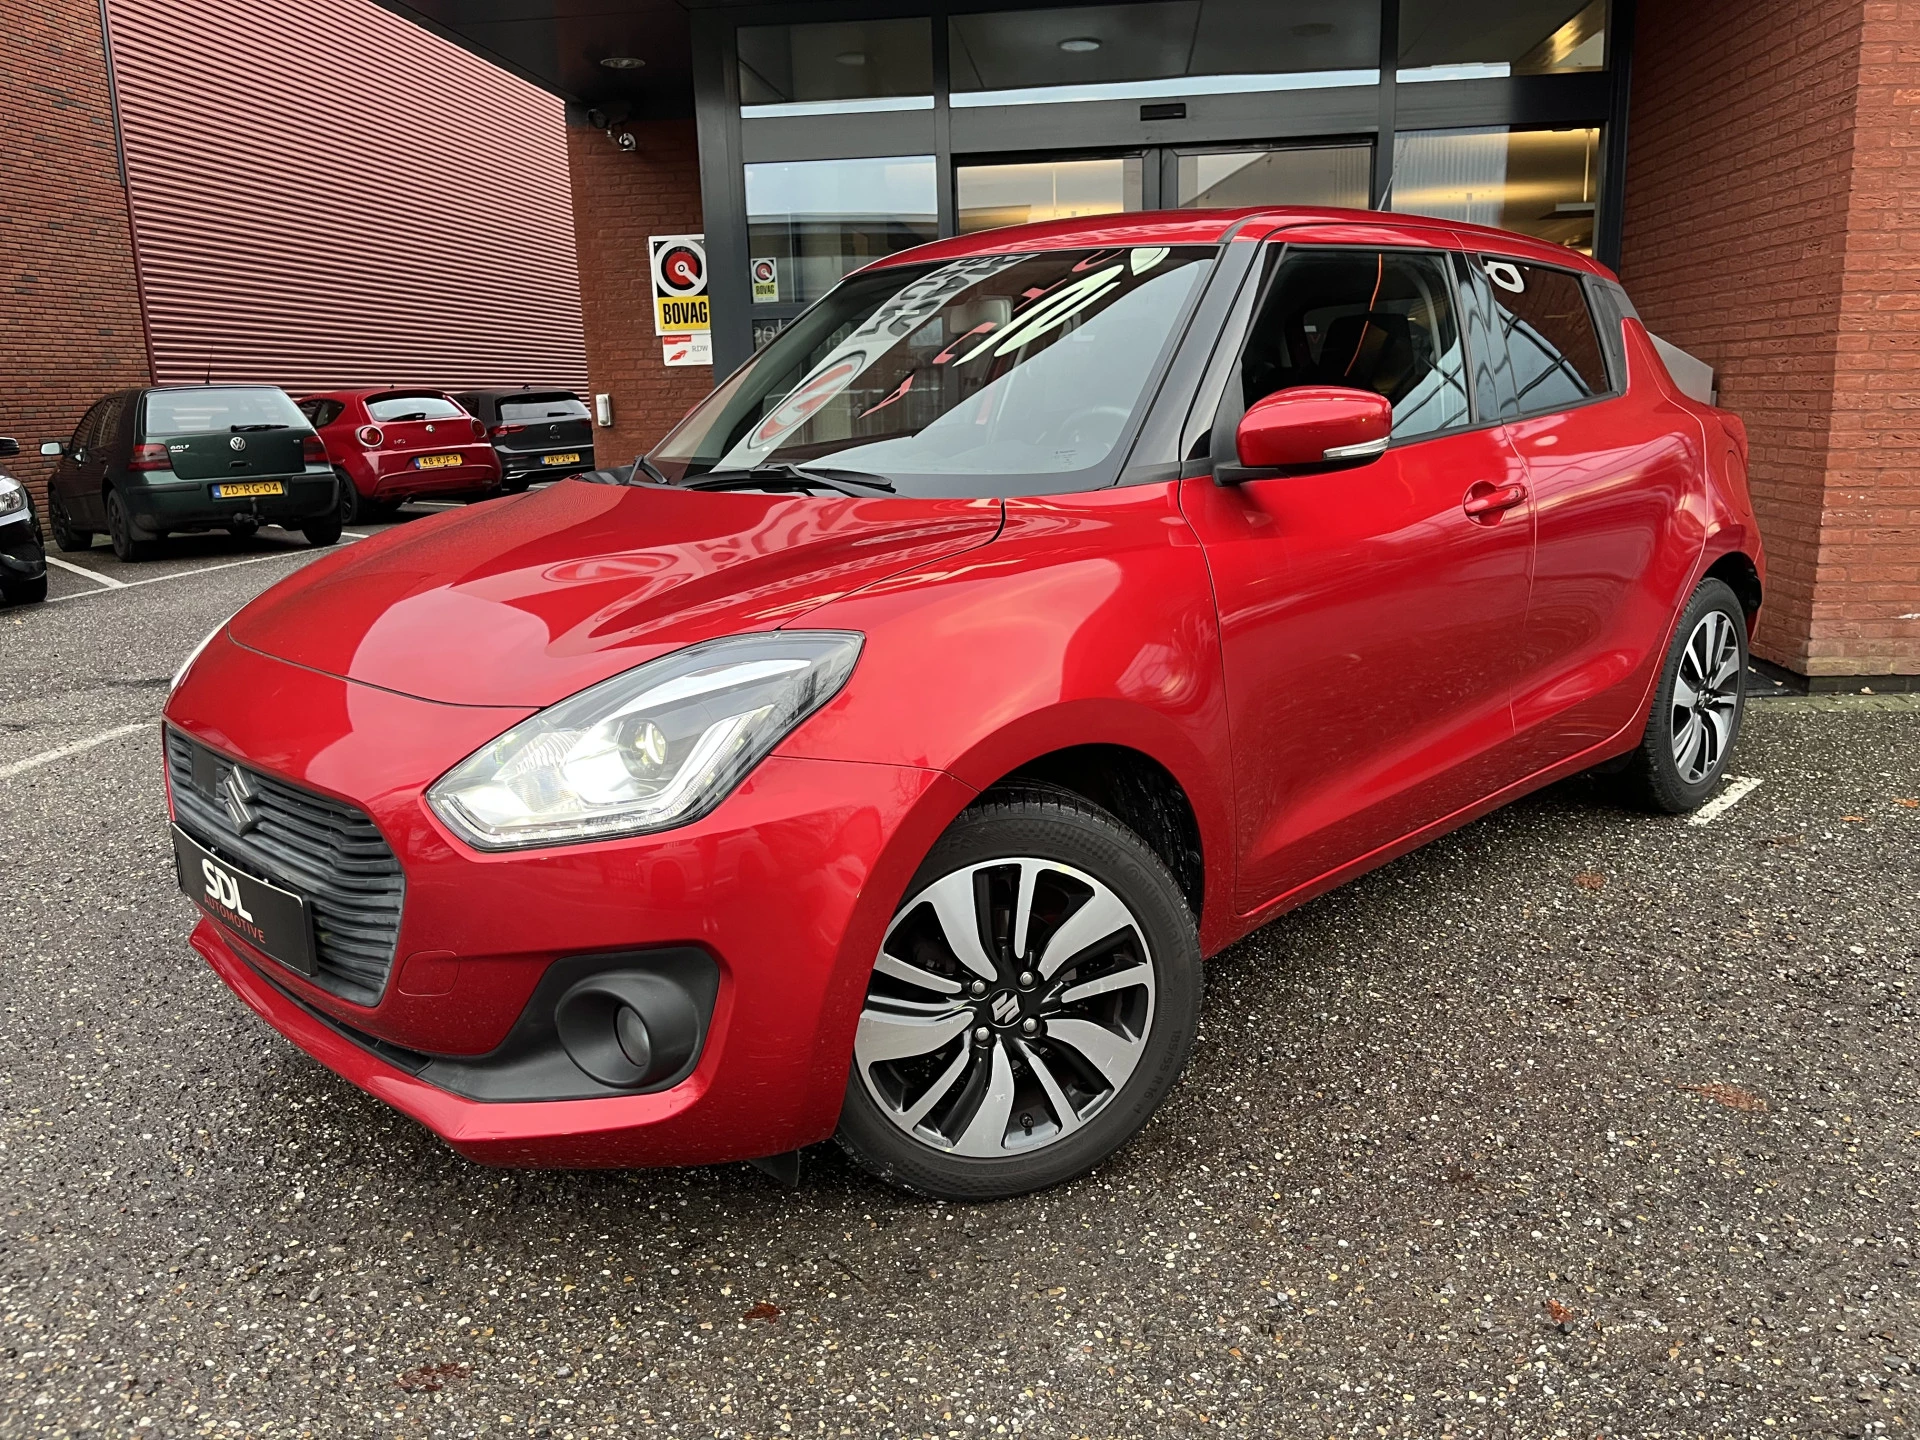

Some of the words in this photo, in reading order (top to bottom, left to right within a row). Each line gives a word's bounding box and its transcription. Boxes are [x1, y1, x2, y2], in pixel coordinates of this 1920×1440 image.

[755, 284, 775, 295] BOVAG
[662, 301, 708, 325] BOVAG
[691, 345, 709, 353] RDW
[222, 483, 279, 496] ZD-RG-04
[201, 858, 254, 923] SDL
[204, 892, 266, 944] AUTOMOTIVE
